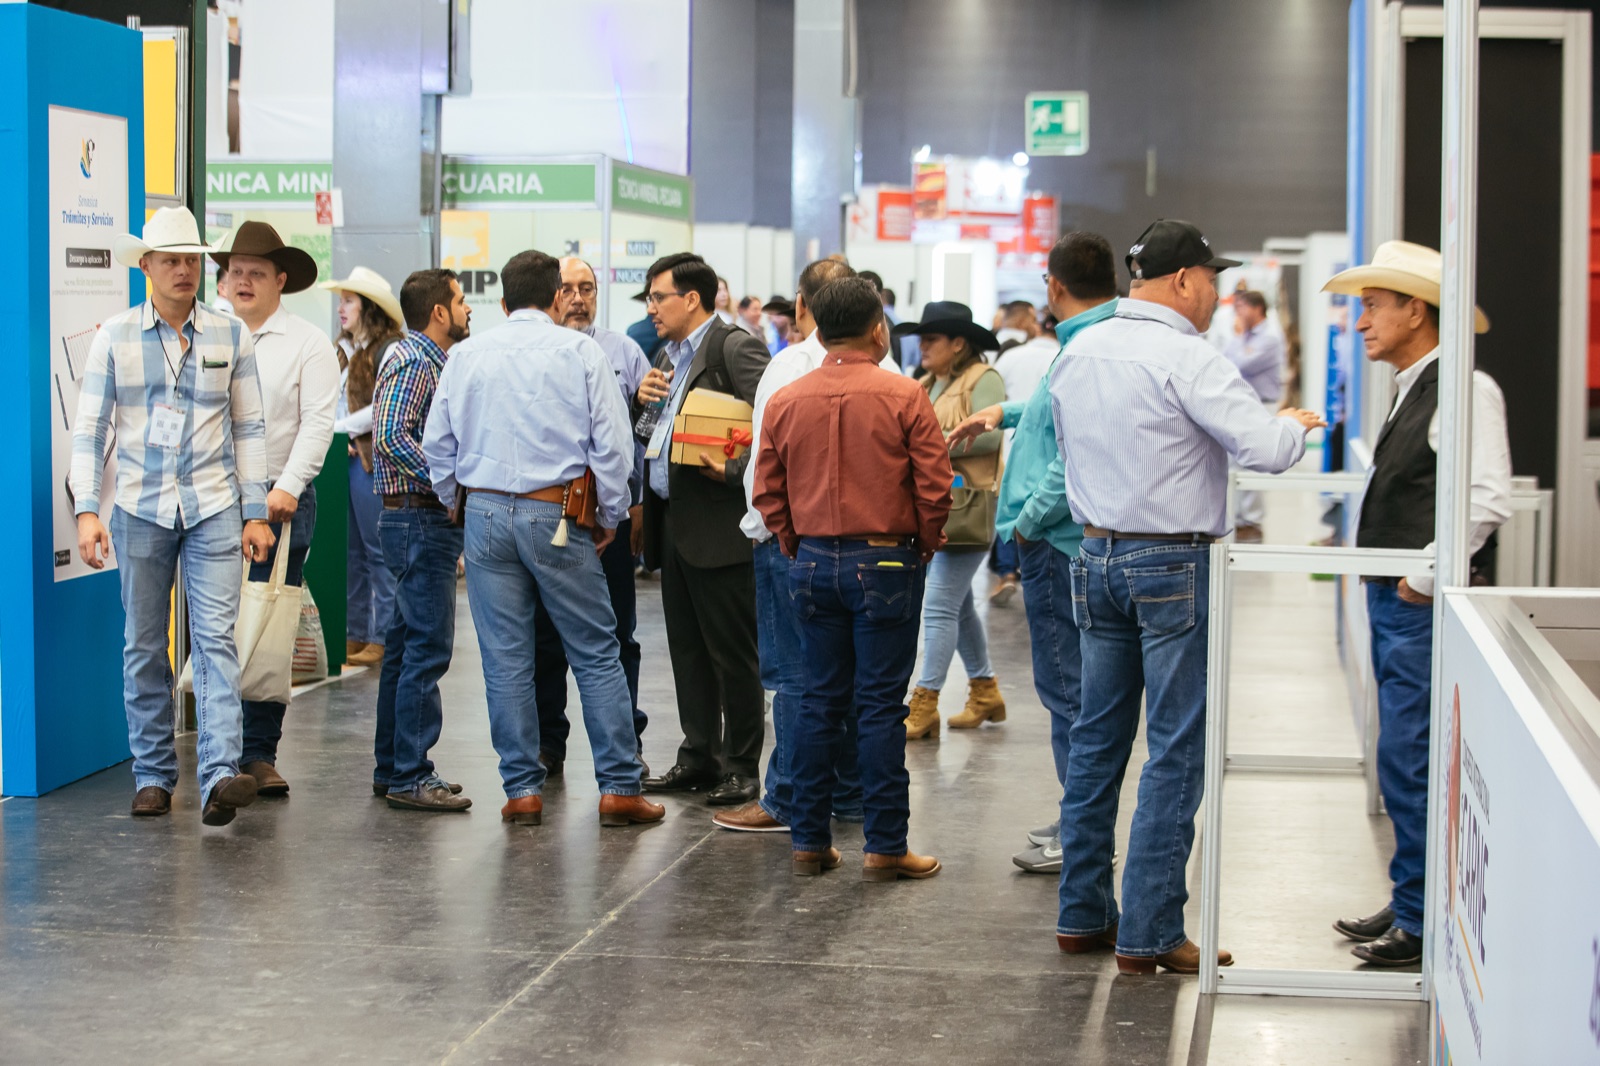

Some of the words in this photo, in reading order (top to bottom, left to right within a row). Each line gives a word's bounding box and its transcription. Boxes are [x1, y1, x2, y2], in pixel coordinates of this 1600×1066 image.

[206, 172, 271, 194] NICA
[278, 172, 332, 194] MIN
[62, 210, 87, 225] Trámites
[92, 212, 114, 227] Servicios
